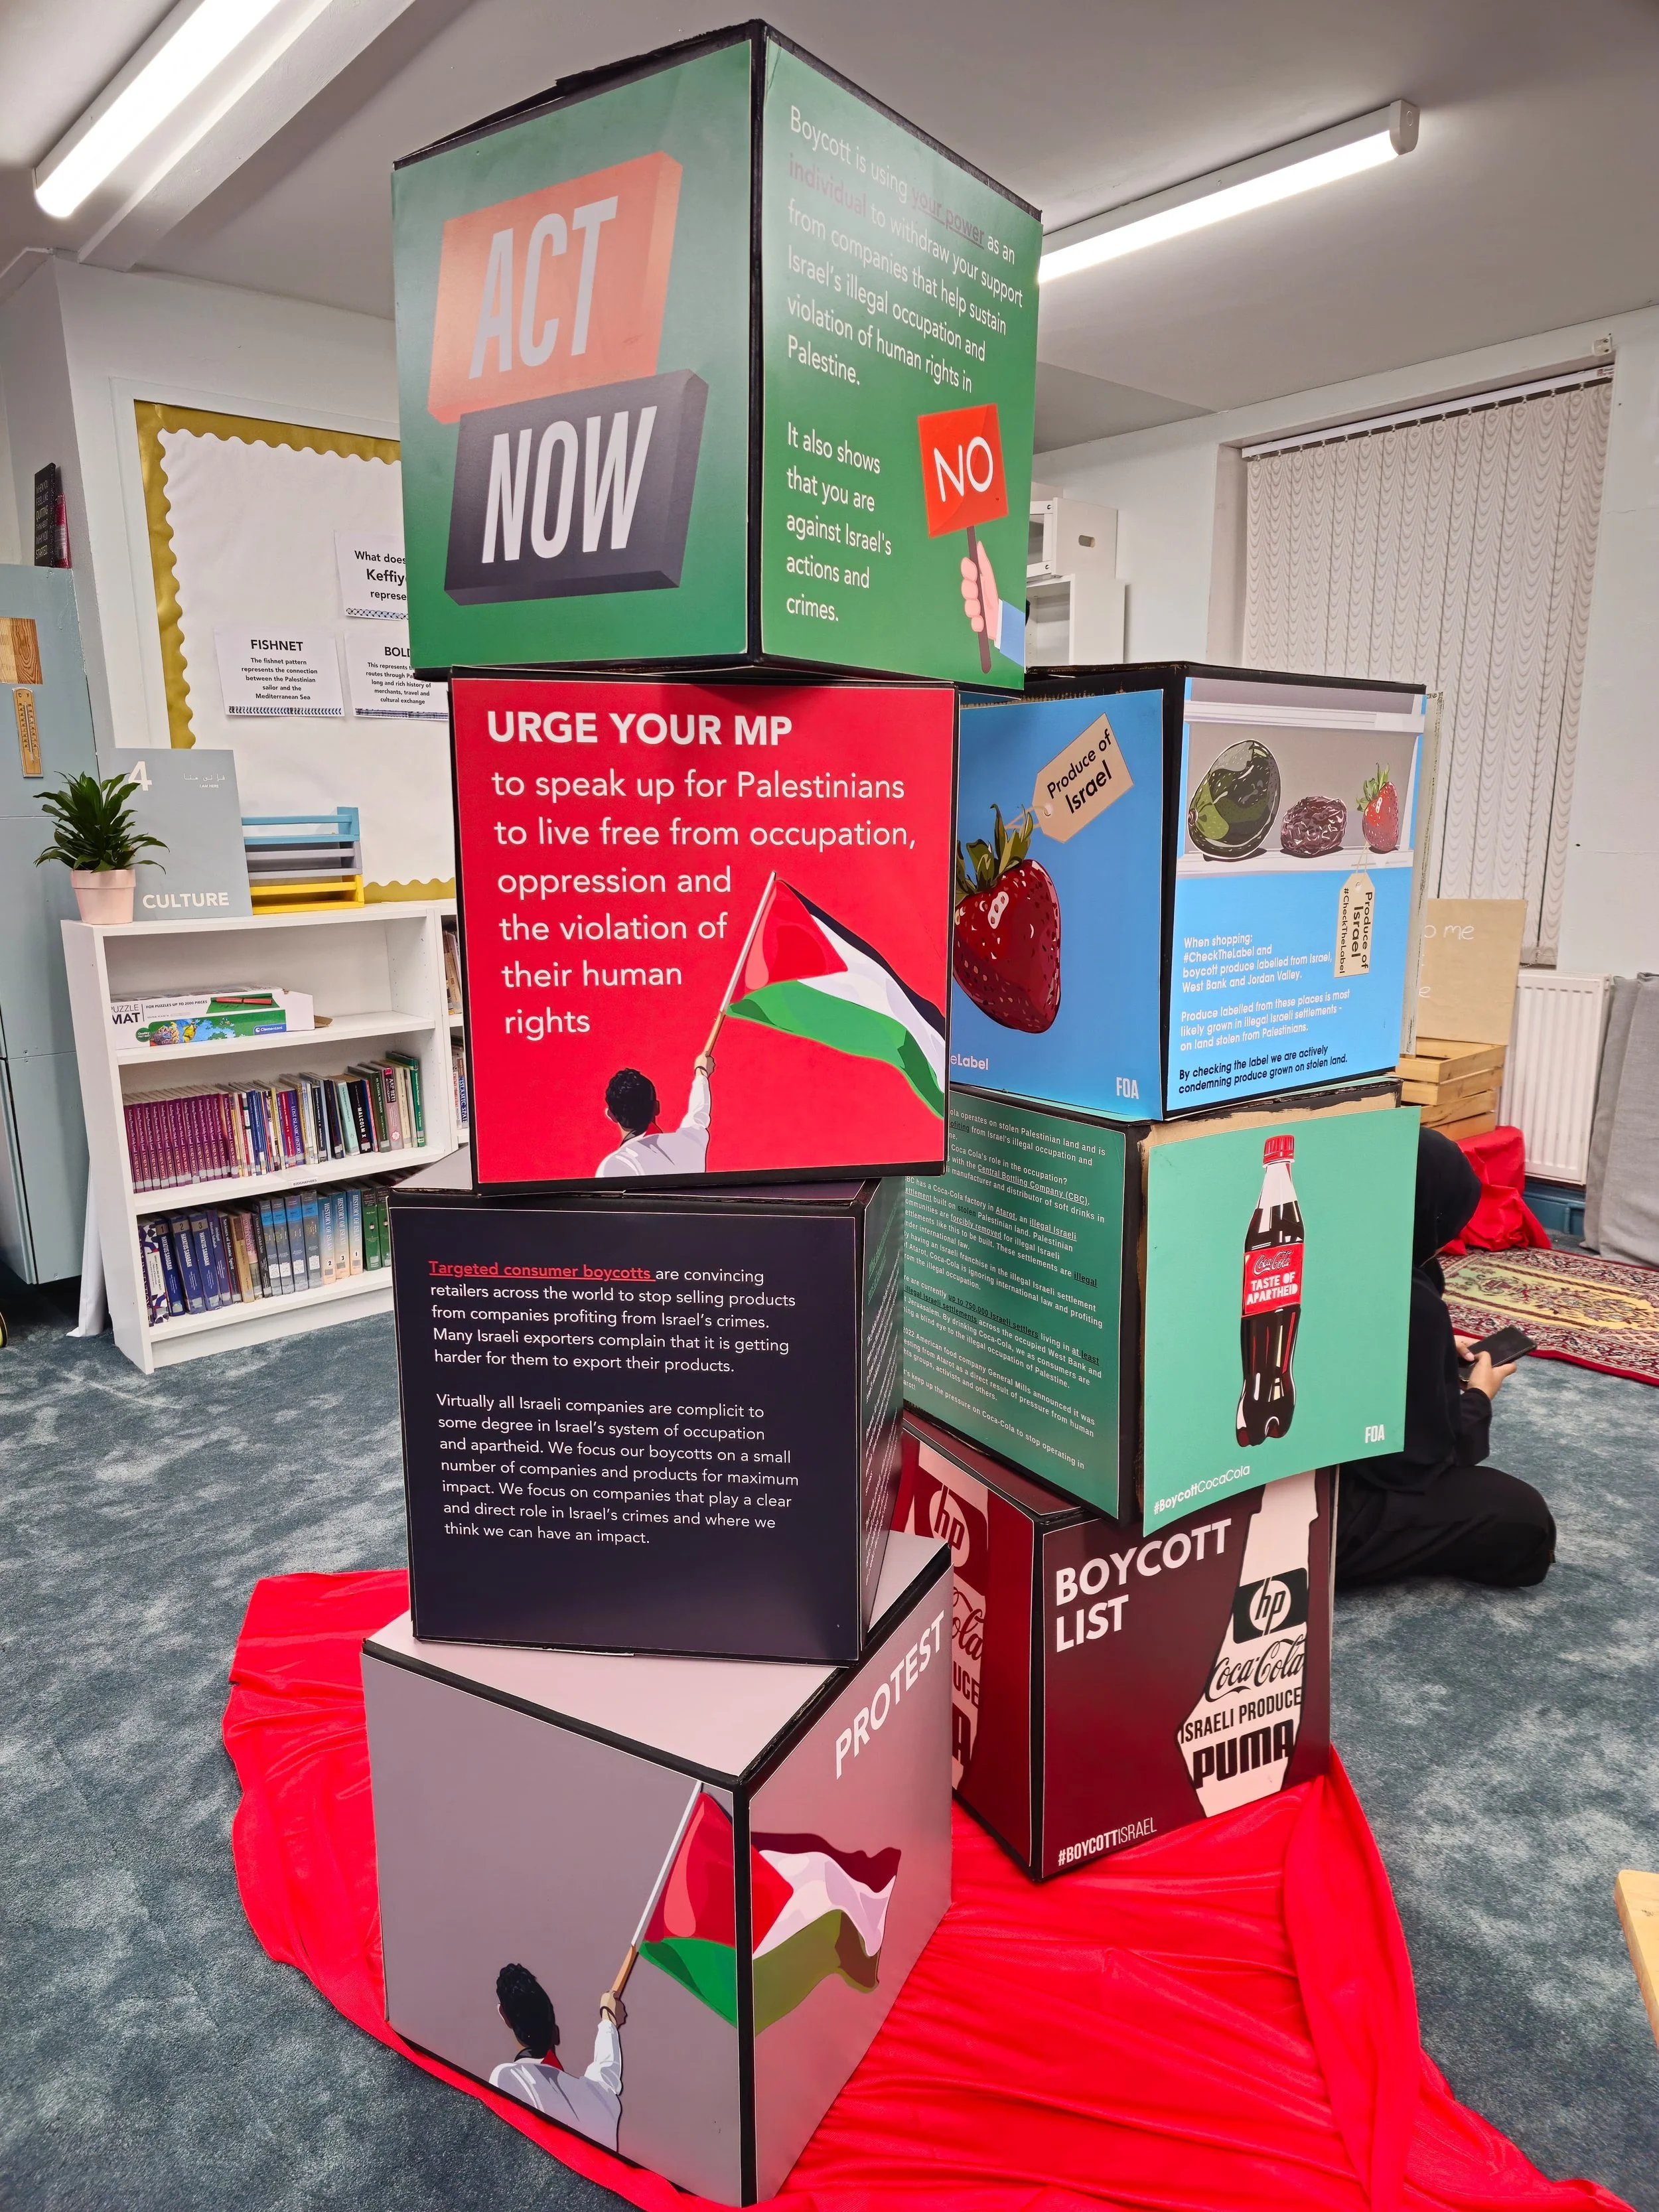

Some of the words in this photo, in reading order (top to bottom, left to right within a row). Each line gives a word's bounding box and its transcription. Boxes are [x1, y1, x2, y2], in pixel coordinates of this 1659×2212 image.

[791, 105, 851, 165] Boycott
[857, 147, 866, 173] is
[871, 160, 908, 204] using
[911, 186, 942, 217] your
[946, 207, 984, 244] power
[987, 236, 999, 256] as
[1002, 245, 1015, 265] an
[790, 153, 867, 217] individual
[871, 204, 886, 227] to
[890, 216, 950, 264] withdraw
[952, 254, 979, 281] your
[981, 271, 1023, 309] support
[789, 199, 826, 240] from
[832, 231, 908, 283] companies
[912, 266, 938, 298] that
[941, 283, 966, 313] help
[970, 301, 1007, 336] sustain
[468, 196, 618, 379] ACT
[481, 406, 657, 564] NOW
[934, 437, 993, 502] NO
[354, 550, 381, 561] What
[250, 639, 303, 652] FISHNET
[488, 711, 598, 743] URGE
[609, 713, 722, 745] YOUR
[735, 715, 792, 745] MP
[128, 761, 152, 792] 4
[1046, 747, 1096, 799] Produce
[1098, 728, 1113, 755] of
[491, 772, 525, 796] to
[536, 768, 626, 804] speak
[637, 778, 674, 804] up
[684, 769, 727, 797] for
[738, 770, 904, 798] Palestinians
[1065, 760, 1112, 814] Israel
[494, 822, 527, 845] to
[539, 816, 589, 845] live
[599, 816, 660, 845] free
[669, 817, 738, 846] from
[750, 820, 915, 853] occupation,
[143, 892, 229, 909] CULTURE
[498, 867, 666, 901] oppression
[678, 865, 731, 893] and
[498, 913, 549, 941] the
[559, 913, 687, 940] violation
[698, 911, 728, 939] of
[1339, 888, 1350, 974] #CheckTheLabel
[1351, 906, 1364, 958] Israel
[1362, 892, 1373, 950] Produce
[1443, 924, 1475, 940] me
[501, 960, 572, 988] their
[583, 960, 682, 986] human
[1361, 954, 1368, 969] of
[505, 1006, 590, 1041] rights
[1179, 1069, 1190, 1081] By
[1192, 1063, 1232, 1077] checking
[1234, 1059, 1246, 1070] the
[1249, 1055, 1269, 1067] label
[1271, 1055, 1282, 1063] we
[1284, 1052, 1297, 1061] are
[1299, 1045, 1329, 1058] actively
[1116, 1076, 1139, 1100] FOA
[357, 1106, 366, 1133] MALCOLM
[961, 1112, 987, 1125] operates
[999, 1123, 1019, 1134] stolen
[1021, 1128, 1060, 1144] Palestinian
[1063, 1138, 1079, 1149] land
[1082, 1144, 1096, 1153] and
[428, 1261, 499, 1280] Targeted
[504, 1266, 578, 1279] consumer
[583, 1266, 651, 1282] boycotts
[656, 1269, 679, 1280] are
[684, 1268, 764, 1287] convincing
[1251, 1275, 1281, 1291] TASTE
[1283, 1272, 1296, 1284] OF
[1246, 1283, 1298, 1305] APARTHEID
[1364, 1424, 1384, 1443] FOA
[1153, 1465, 1250, 1515] #BoycottCocaCola
[1056, 1518, 1232, 1606] BOYCOTT
[1056, 1595, 1129, 1653] LIST
[1255, 1578, 1286, 1636] hp
[836, 1610, 944, 1780] PROTEST
[1180, 1708, 1235, 1744] ISRAELI
[1239, 1686, 1301, 1723] PRODUCE
[1192, 1719, 1297, 1789] PUMA
[1058, 1817, 1157, 1866] #BOYCOTTISRAEL
